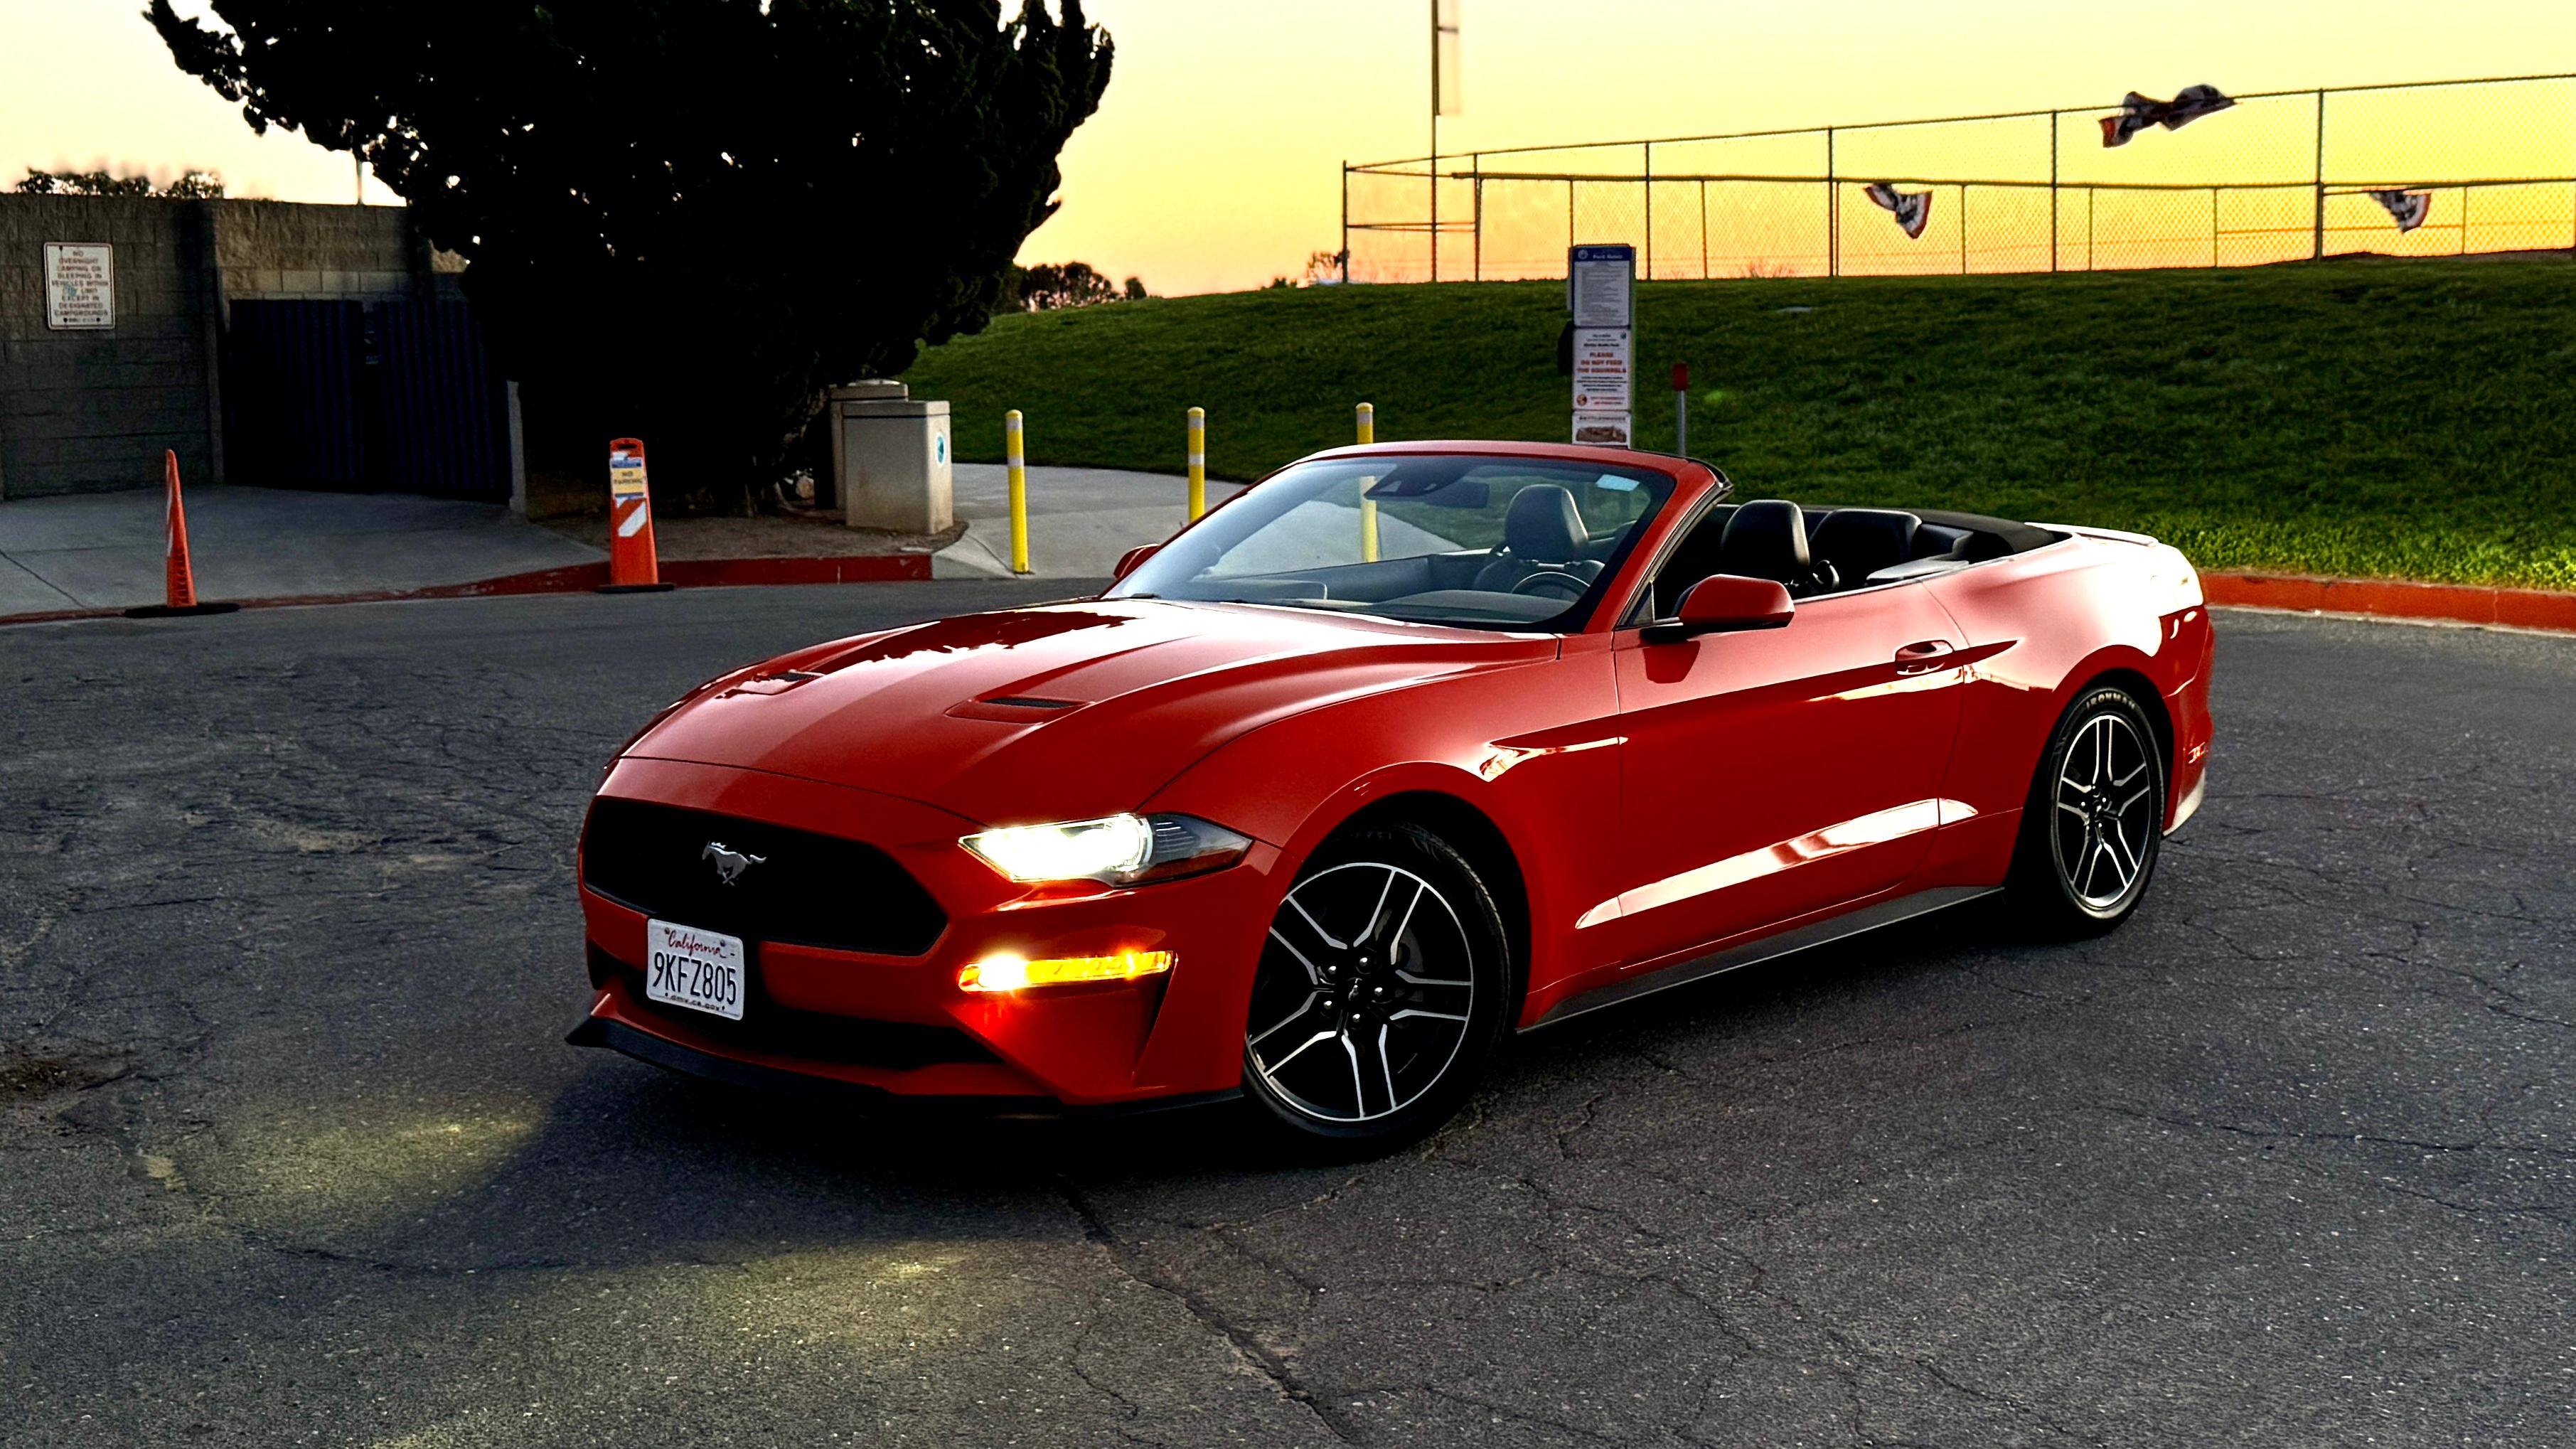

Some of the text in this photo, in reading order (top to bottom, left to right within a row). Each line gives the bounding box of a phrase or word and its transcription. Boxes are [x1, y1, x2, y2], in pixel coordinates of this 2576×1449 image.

[2085, 692, 2136, 710] IRONMAN
[667, 929, 727, 958] California
[652, 951, 737, 1005] 9KFZ805
